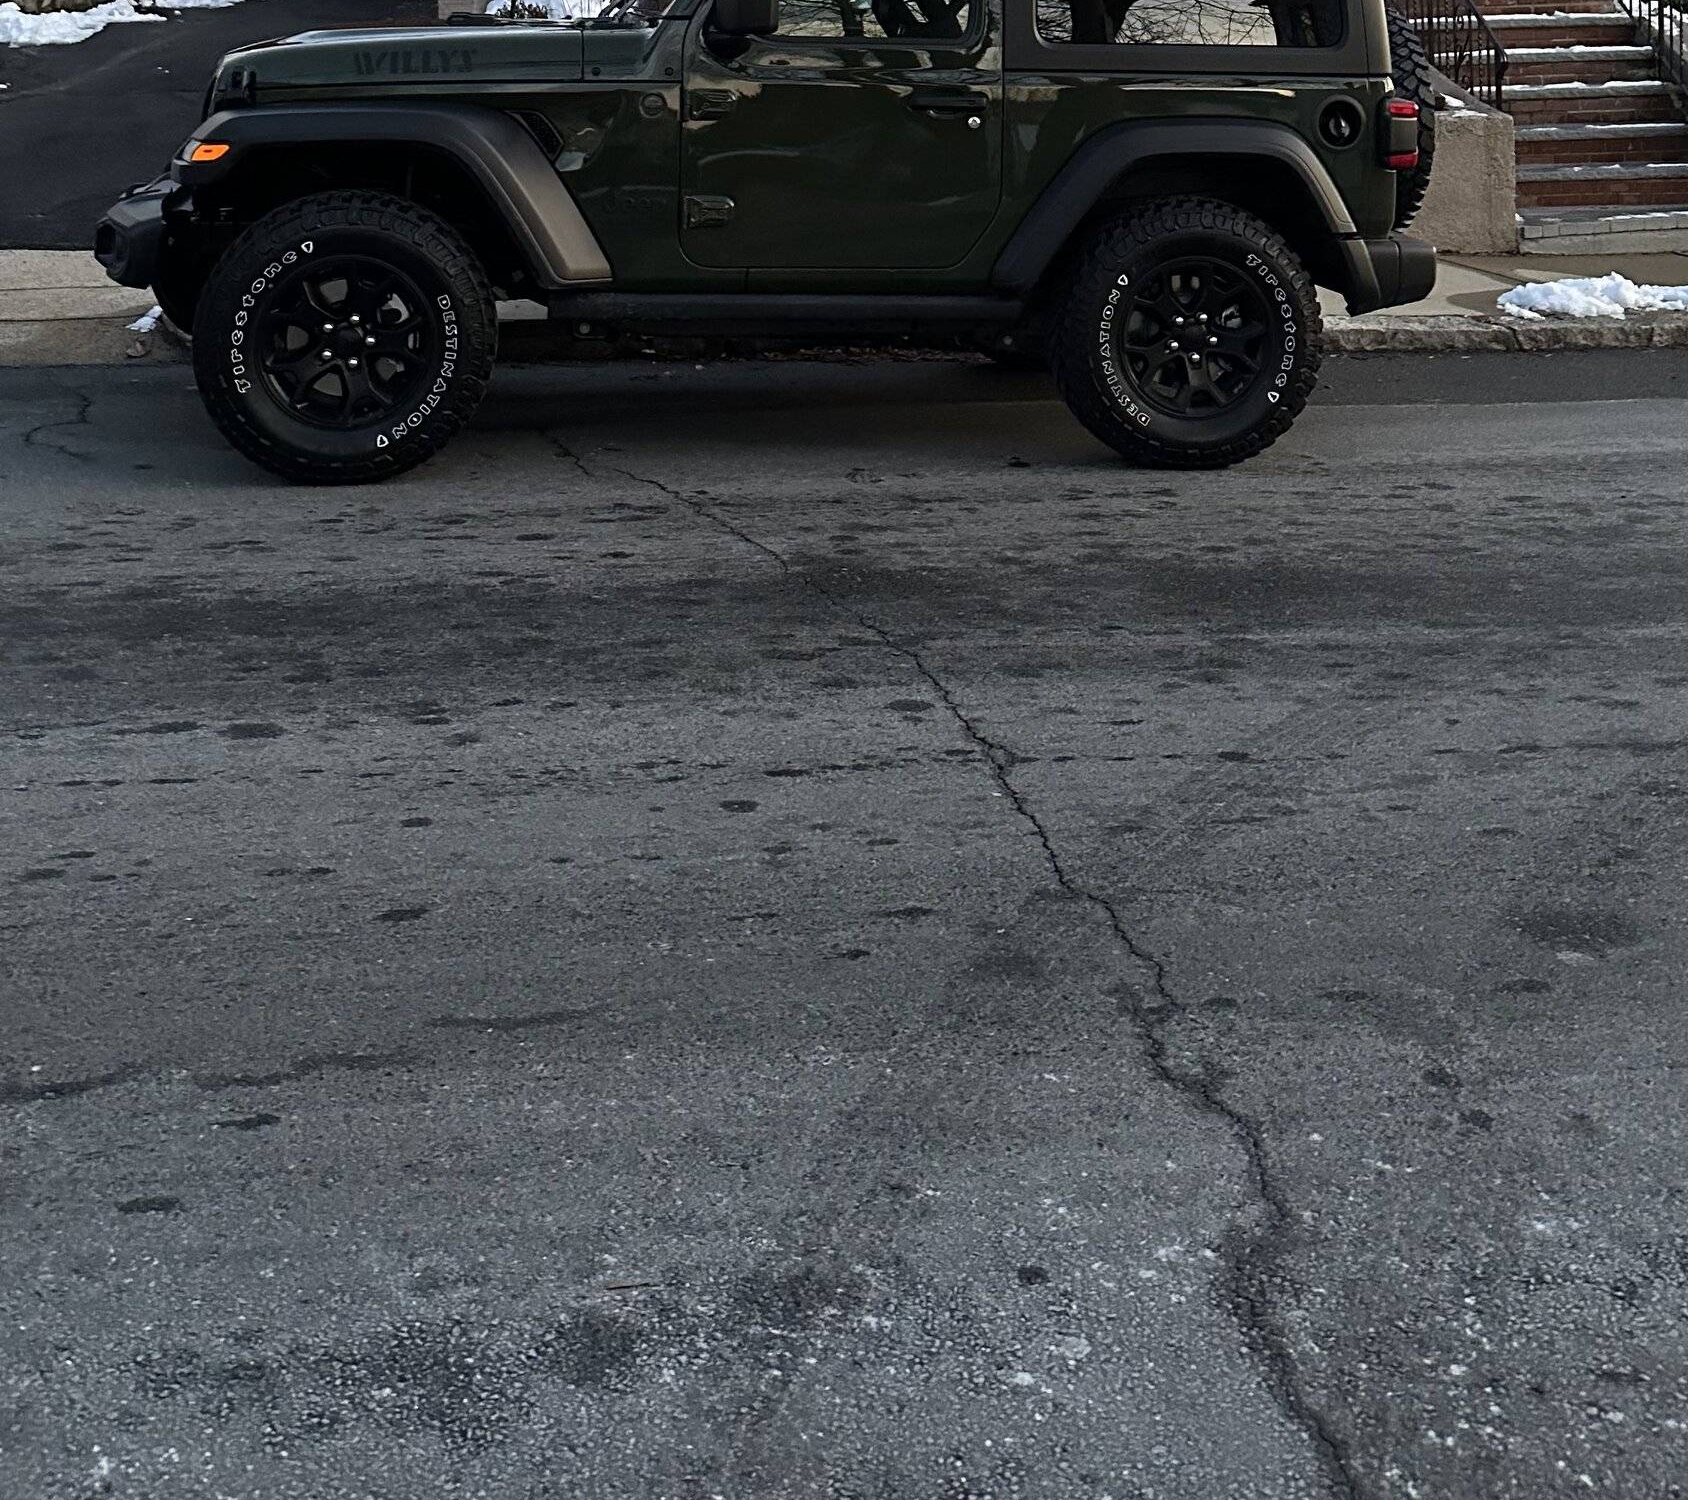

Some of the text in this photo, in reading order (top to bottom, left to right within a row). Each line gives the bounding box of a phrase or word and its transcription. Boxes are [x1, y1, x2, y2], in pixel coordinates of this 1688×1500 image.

[353, 49, 477, 75] WILLYS
[393, 295, 458, 438] DESTINATION
[1100, 289, 1150, 426] DESTINATION
